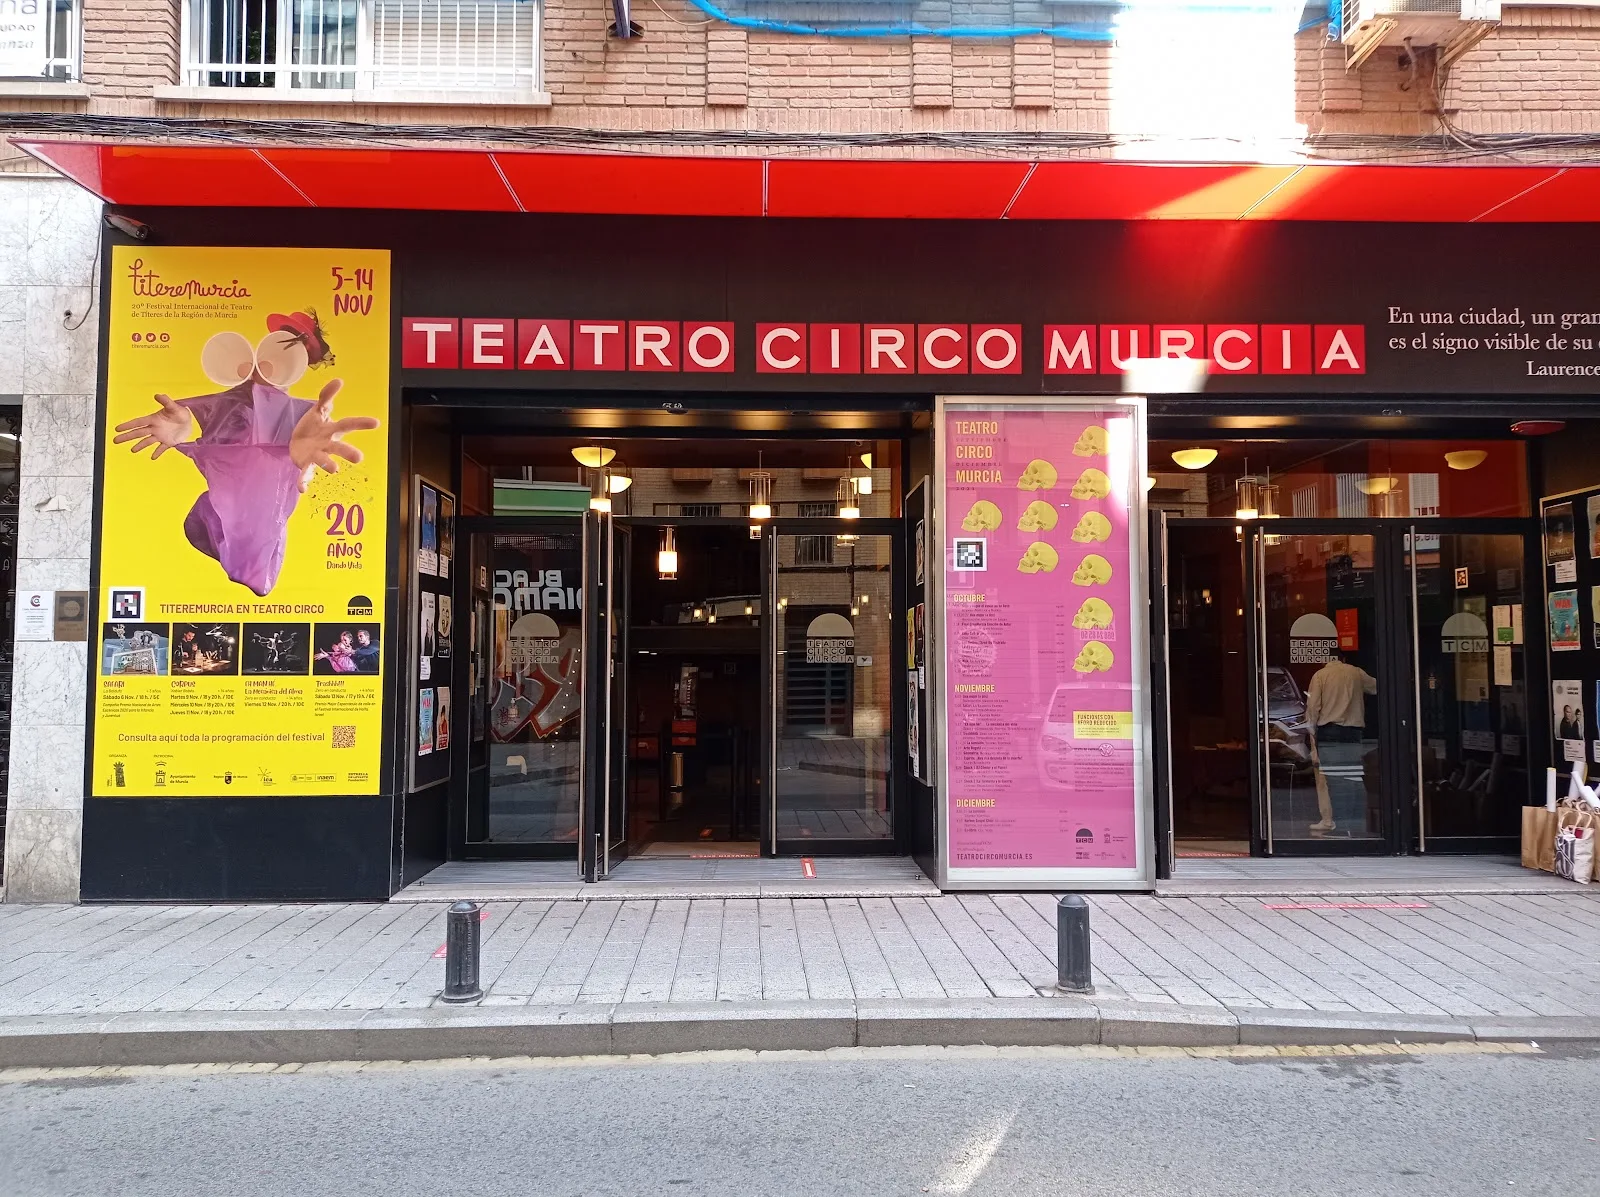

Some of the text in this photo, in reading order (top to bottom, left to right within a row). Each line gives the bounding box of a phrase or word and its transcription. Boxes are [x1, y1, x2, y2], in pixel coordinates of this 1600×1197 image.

[331, 266, 374, 290] 5-14
[334, 294, 373, 316] NOV
[1388, 306, 1414, 324] En
[1420, 312, 1454, 324] una
[1459, 308, 1526, 328] ciudad,
[1532, 313, 1556, 325] un
[412, 322, 1360, 370] TEATRO CIRCO MURCIA
[1388, 332, 1593, 355] es el signo visible de su
[1526, 361, 1600, 376] Laurence
[956, 422, 998, 434] TEATRO
[956, 446, 993, 459] CIRCO
[956, 470, 1002, 483] MURCIA
[326, 503, 364, 535] 20
[954, 594, 985, 602] OCTUBRE
[160, 604, 324, 614] TITEREMURCIA EN TEATRO CIRCO
[1444, 642, 1488, 650] TCM
[954, 685, 995, 693] NOVIEMBRE
[159, 733, 178, 744] aquí
[212, 733, 275, 744] programación
[956, 799, 995, 808] DICIEMBRE
